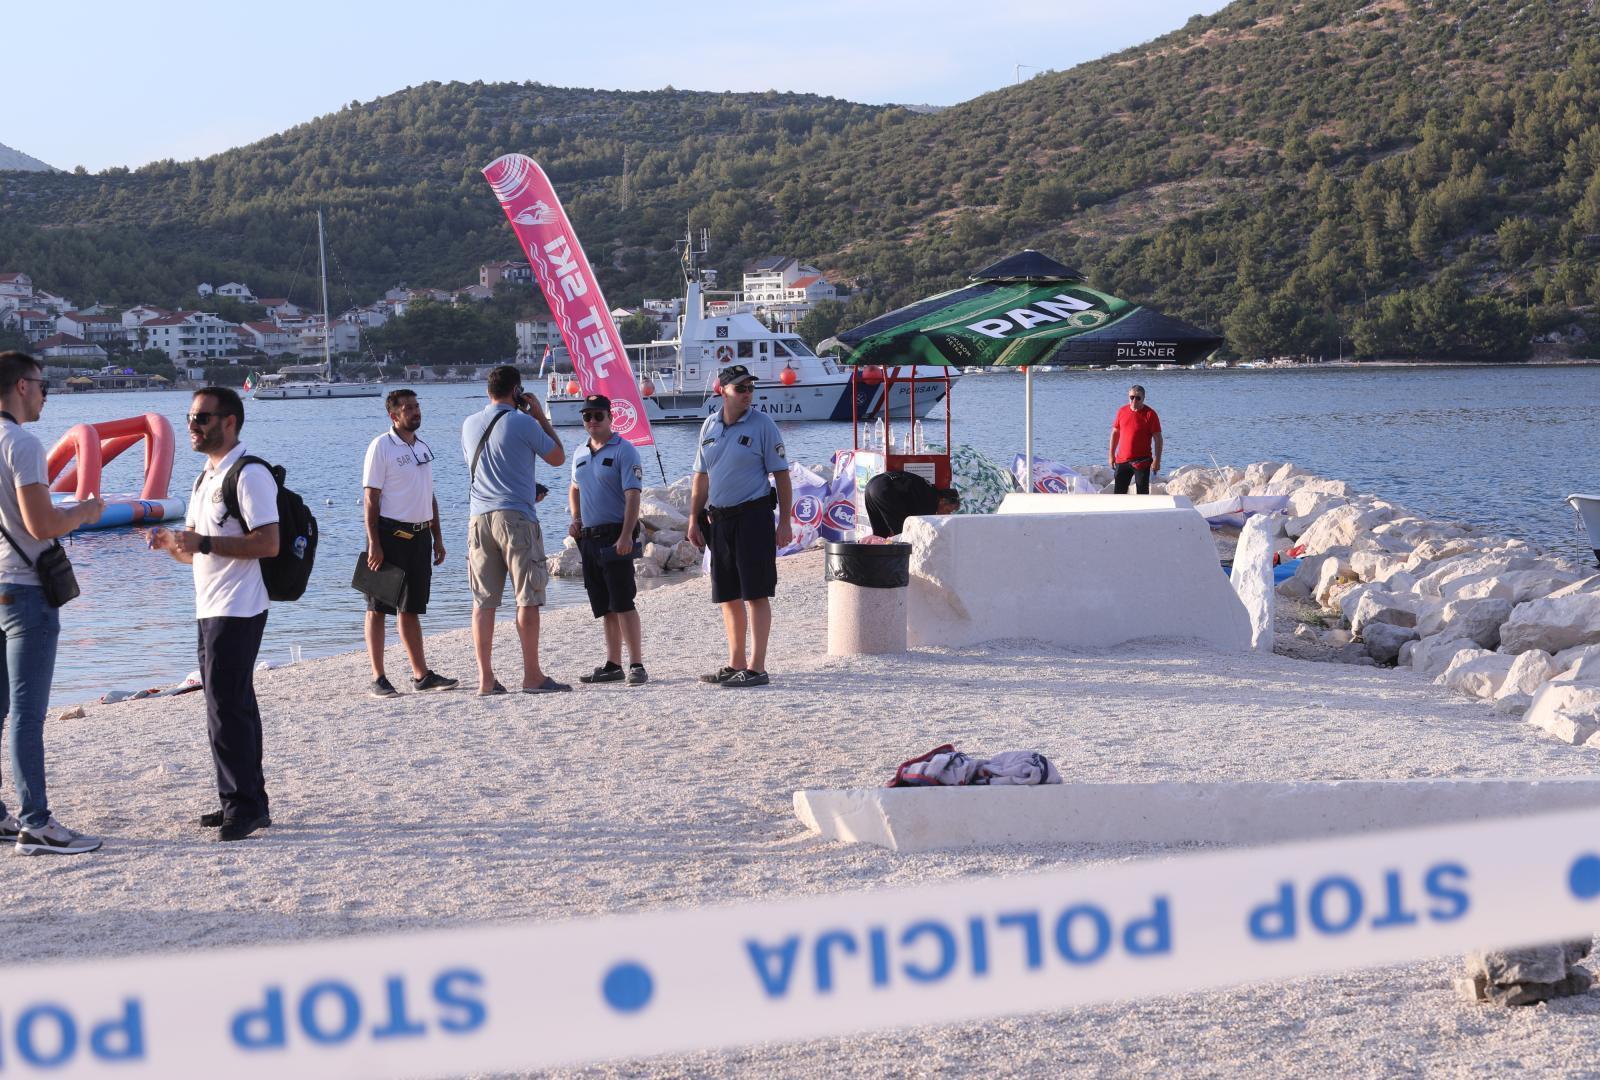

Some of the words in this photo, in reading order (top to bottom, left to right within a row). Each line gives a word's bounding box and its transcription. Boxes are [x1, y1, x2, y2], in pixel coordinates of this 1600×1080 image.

[966, 294, 1094, 338] PAN
[1117, 348, 1175, 357] PILSNER
[708, 403, 802, 414] KTANIJA
[834, 506, 855, 524] led
[1247, 861, 1471, 942] STOP
[744, 895, 1174, 1000] POLICIJA
[229, 967, 489, 1052] STOP
